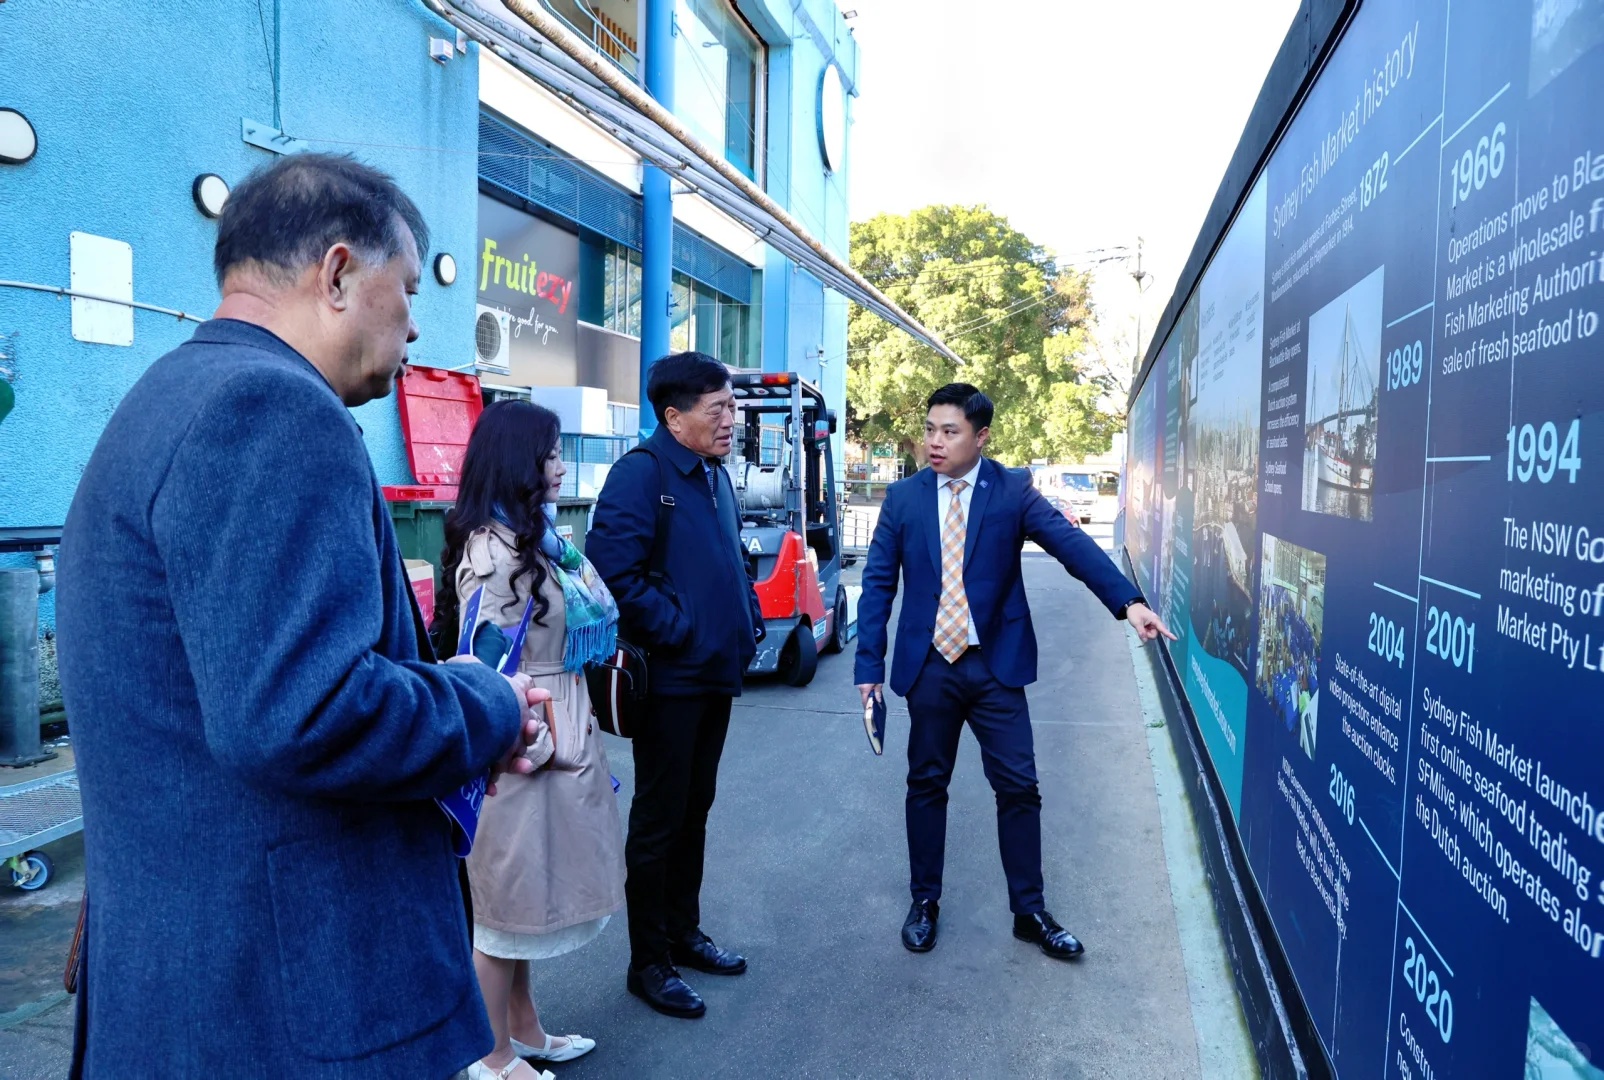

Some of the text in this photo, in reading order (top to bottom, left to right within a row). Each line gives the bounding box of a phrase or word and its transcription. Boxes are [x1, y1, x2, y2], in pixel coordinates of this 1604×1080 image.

[1273, 20, 1419, 239] Sydney Fish Market history
[1360, 151, 1389, 212] 1872
[1451, 121, 1506, 209] 1966
[1448, 211, 1508, 265] Operations
[1511, 187, 1548, 227] move
[1552, 174, 1569, 203] to
[479, 237, 572, 314] fruitezy
[1446, 262, 1483, 301] Market
[1485, 256, 1495, 283] is
[1497, 254, 1506, 277] a
[1508, 210, 1585, 271] wholesale
[514, 306, 535, 338] good
[534, 314, 544, 335] for
[542, 324, 559, 345] you.
[1442, 308, 1599, 375] sale of fresh seafood to
[1444, 307, 1465, 338] Fish
[1467, 286, 1530, 330] Marketing
[1386, 339, 1423, 392] 1989
[1506, 418, 1582, 484] 1994
[1503, 517, 1528, 549] The
[1531, 521, 1573, 557] NSW
[1499, 566, 1577, 617] marketing
[1368, 611, 1405, 669] 2004
[1425, 605, 1476, 674] 2001
[1496, 604, 1547, 651] Market
[1550, 622, 1580, 669] Pty
[1329, 676, 1398, 752] video projectors enhance
[1335, 652, 1402, 721] State-of-the-art digital
[1342, 715, 1396, 785] the auction clocks.
[1422, 687, 1458, 735] Sydney
[1459, 711, 1483, 751] Fish
[1485, 728, 1533, 787] Market
[1329, 763, 1356, 826] 2016
[1420, 722, 1440, 758] first
[1440, 746, 1472, 785] online
[1474, 771, 1526, 836] seafood
[1529, 810, 1592, 901] trading
[1312, 805, 1336, 858] announces
[1335, 848, 1340, 865] a
[1339, 855, 1352, 884] new
[1415, 794, 1510, 924] the Dutch auction.
[1418, 757, 1457, 820] SFMlive,
[1460, 800, 1493, 858] which
[1495, 841, 1560, 922] operates
[1403, 936, 1453, 1044] 2020
